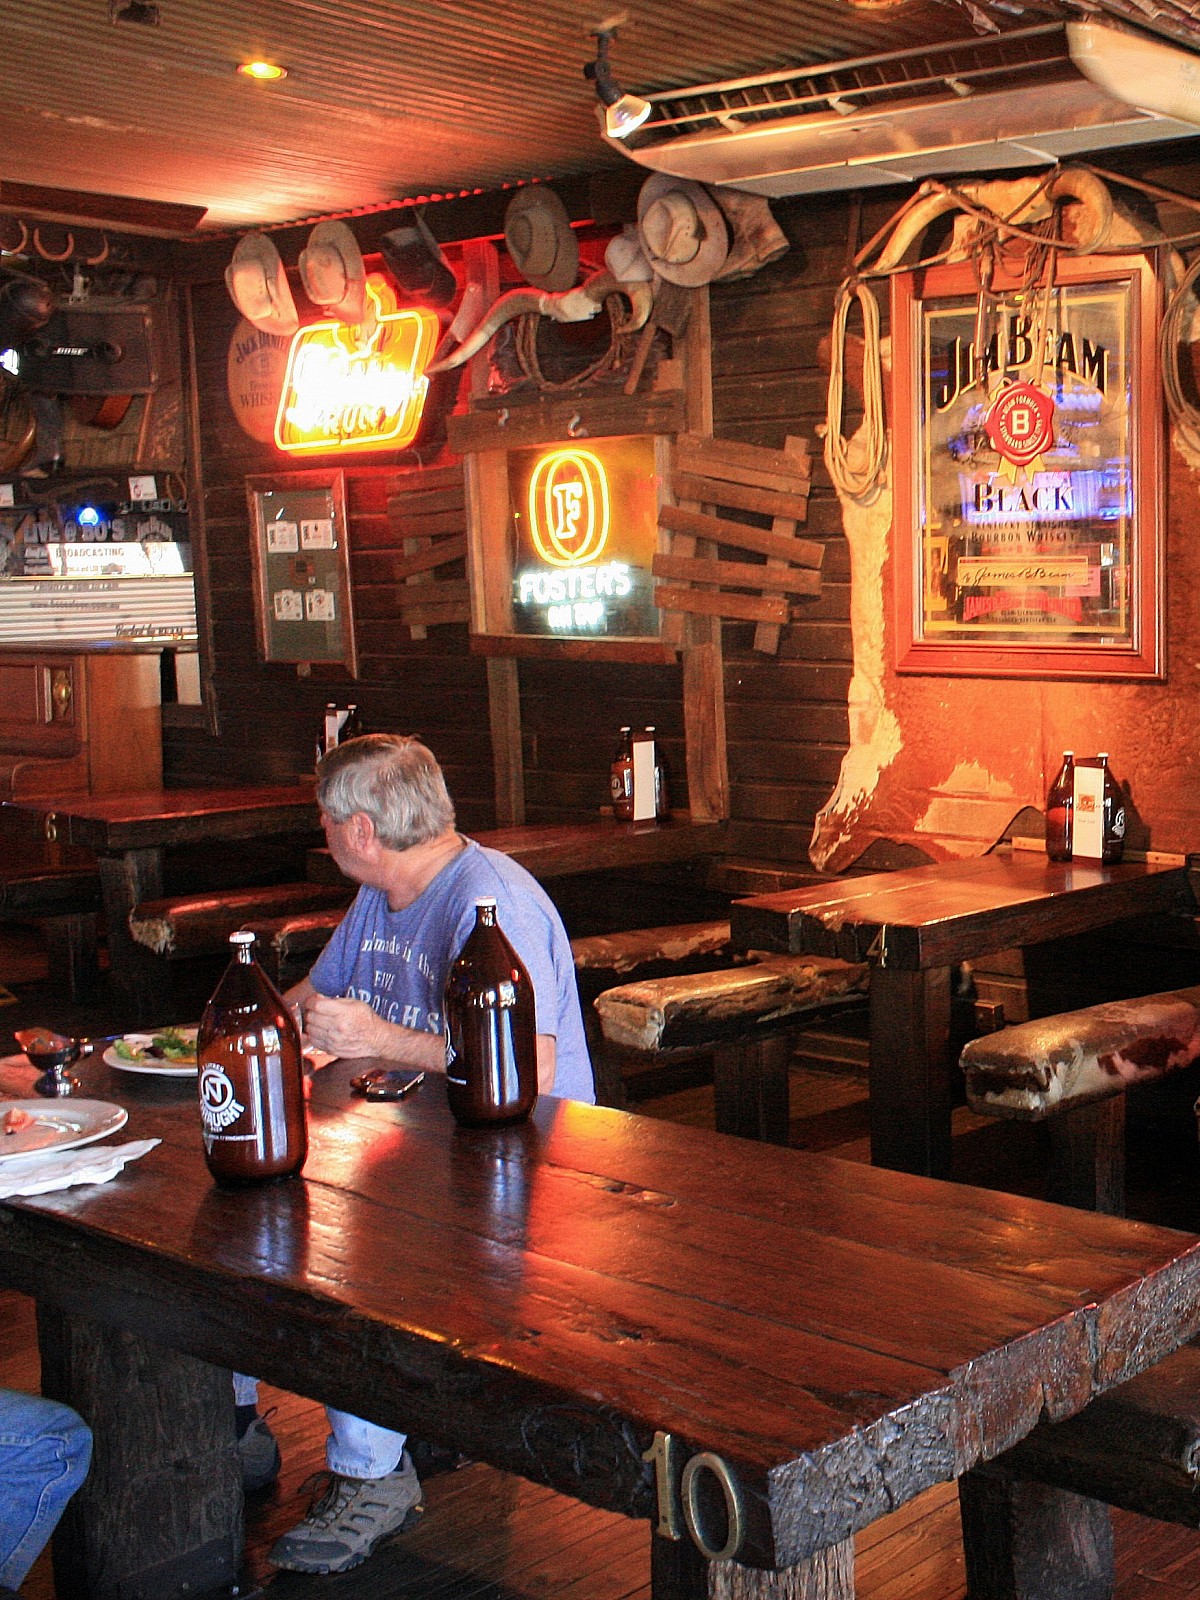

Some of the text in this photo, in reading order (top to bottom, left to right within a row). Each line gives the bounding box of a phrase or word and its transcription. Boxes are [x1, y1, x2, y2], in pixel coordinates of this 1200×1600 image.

[937, 315, 1110, 413] JIM BEAM
[1011, 409, 1030, 435] B
[552, 482, 583, 539] F
[972, 483, 1074, 513] BLACK
[971, 530, 1075, 543] BOURBON WHISKEY
[55, 547, 125, 558] BOADCASTING
[519, 560, 631, 604] FOSTER'S
[374, 970, 395, 992] FIVE
[642, 1431, 739, 1561] 10
